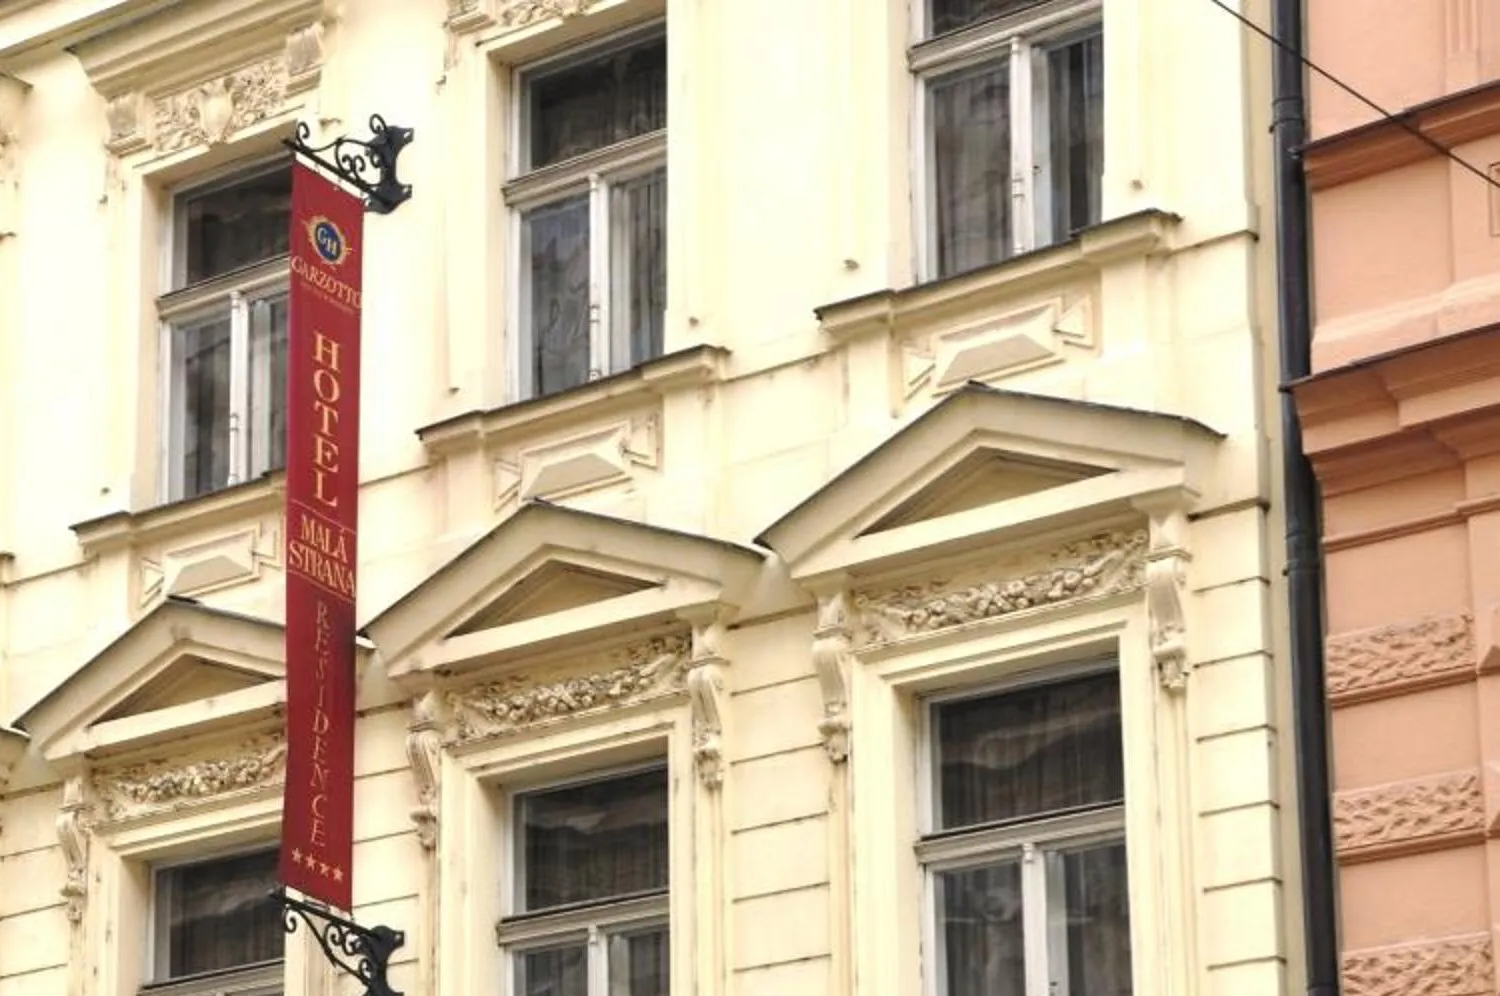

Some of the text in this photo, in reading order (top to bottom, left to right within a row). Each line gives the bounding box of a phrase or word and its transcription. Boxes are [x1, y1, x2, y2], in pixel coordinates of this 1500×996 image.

[312, 332, 341, 507] HOTEL
[289, 539, 356, 598] STRANA
[300, 513, 349, 564] MALÁ
[310, 601, 331, 848] RESIDENCE
